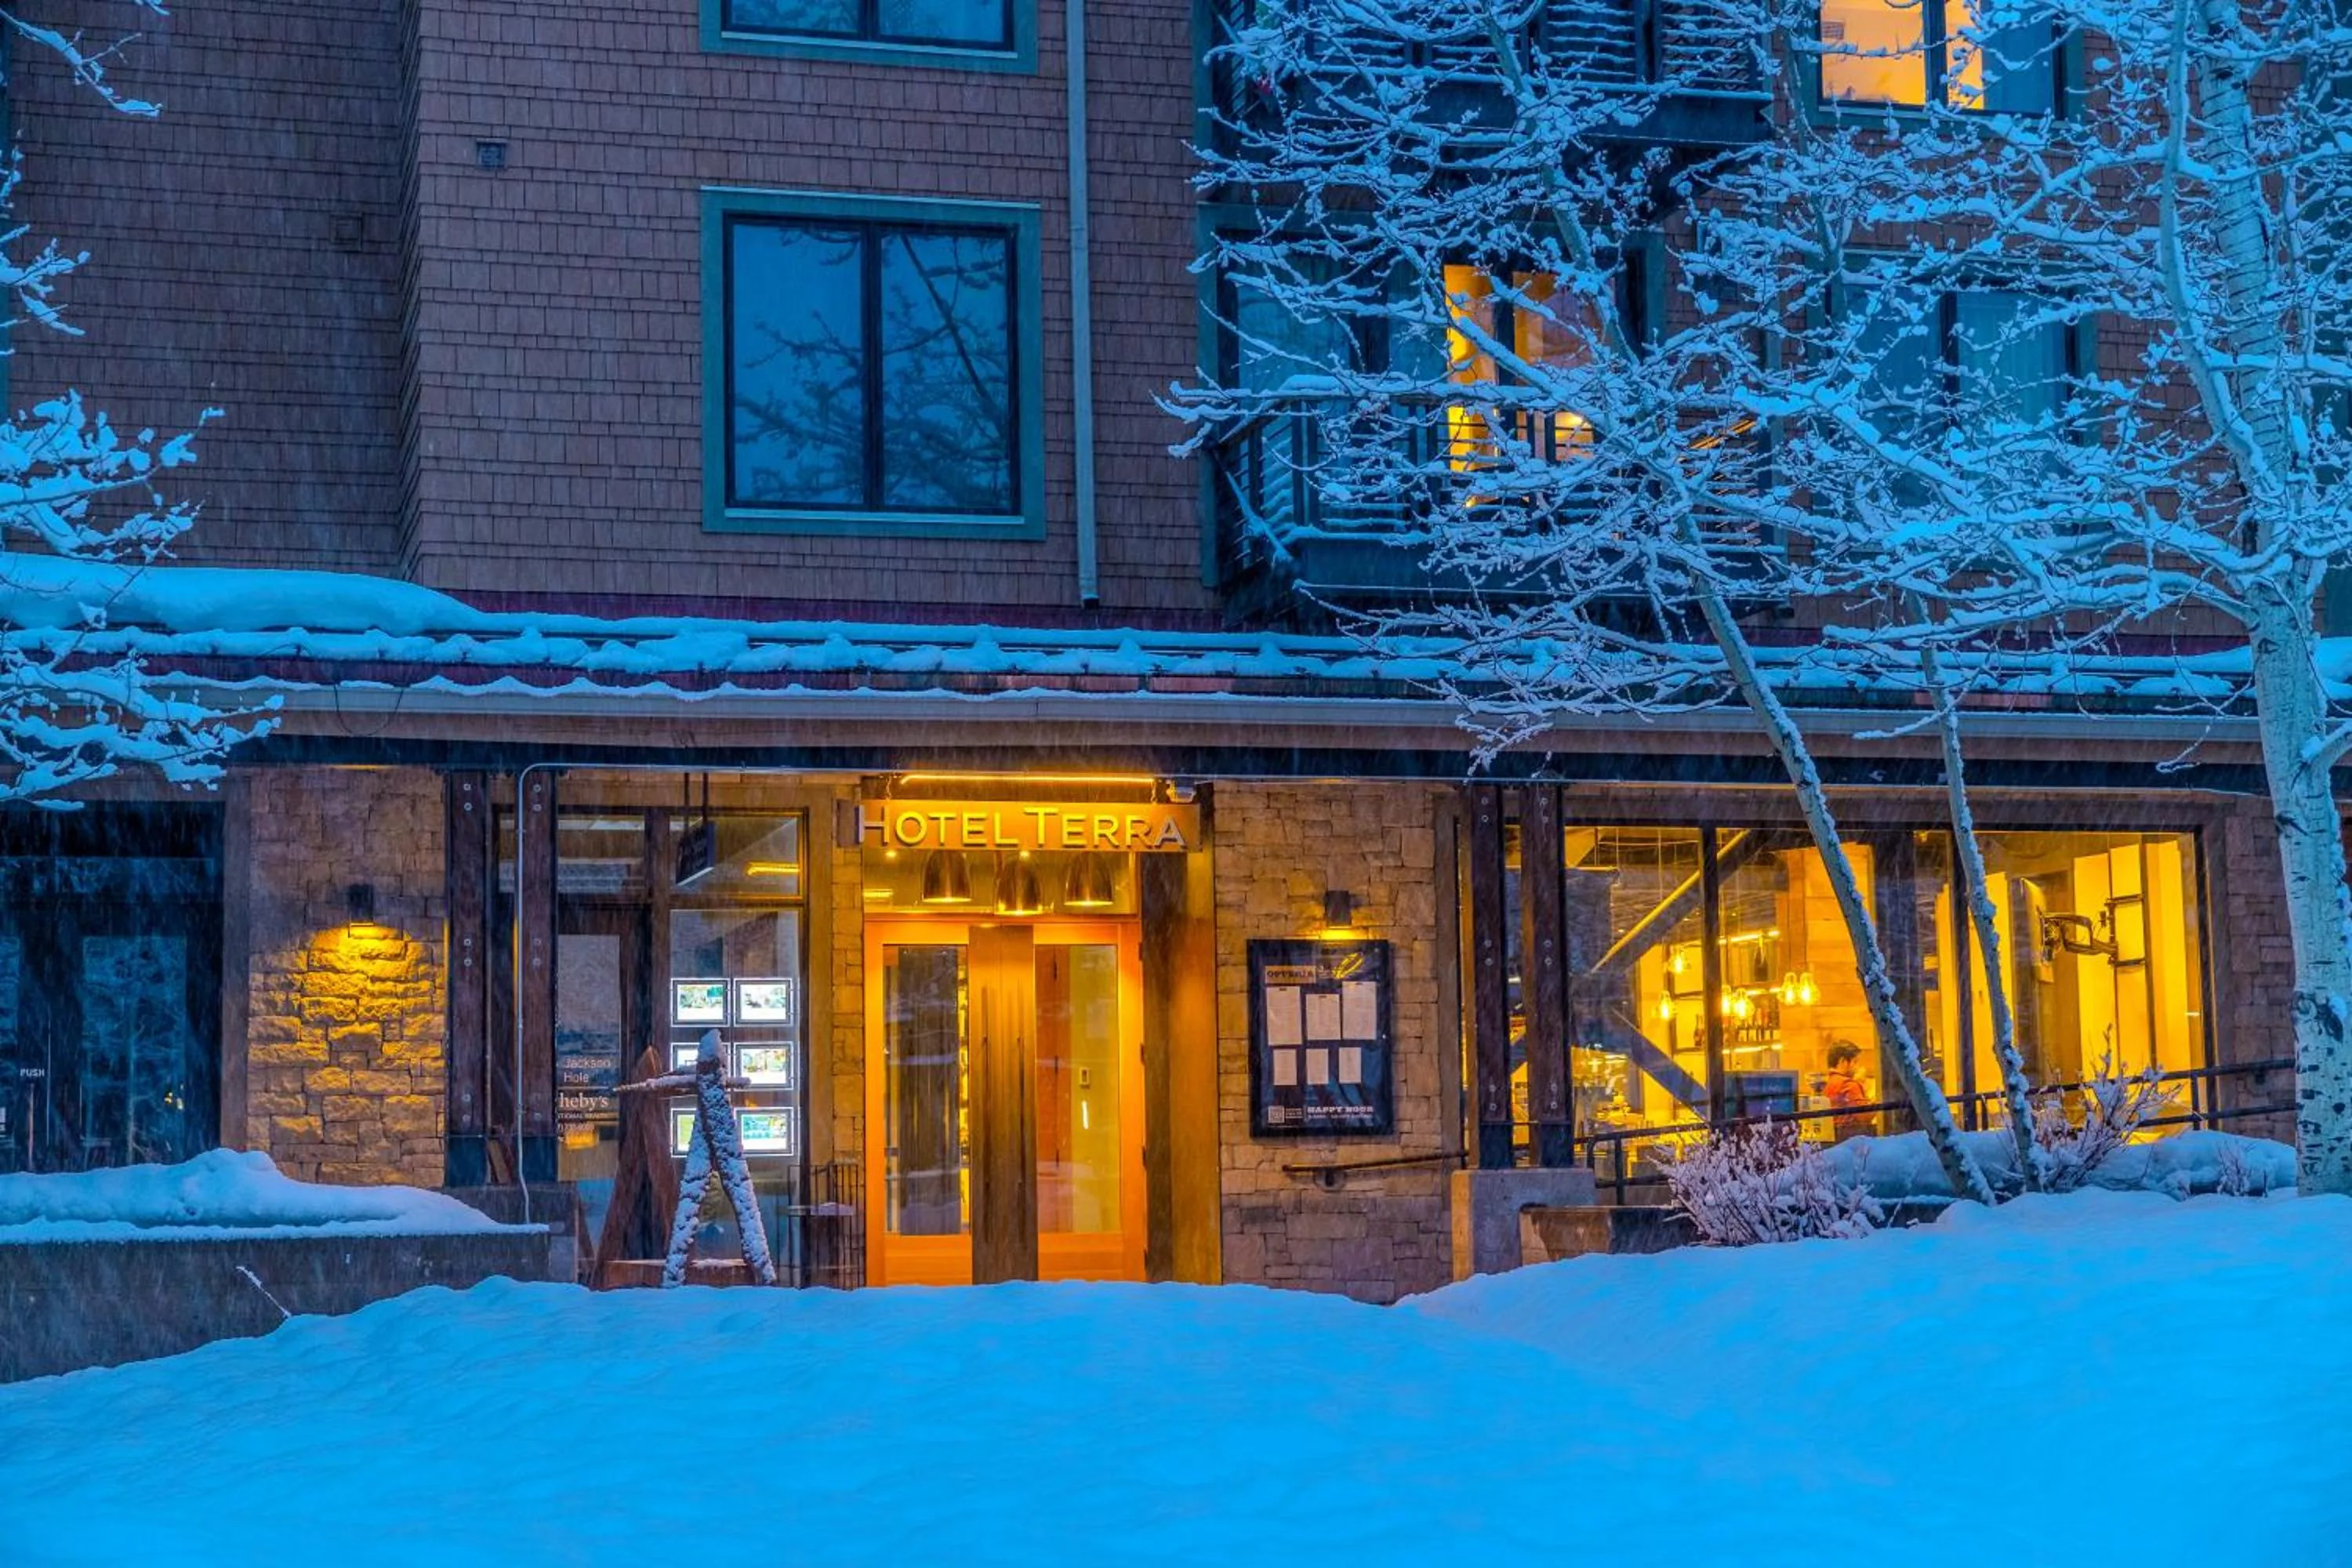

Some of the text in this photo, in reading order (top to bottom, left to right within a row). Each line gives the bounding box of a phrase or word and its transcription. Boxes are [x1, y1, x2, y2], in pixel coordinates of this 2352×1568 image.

[858, 805, 1187, 848] HOTEL TERRA
[564, 1072, 589, 1083] Hole
